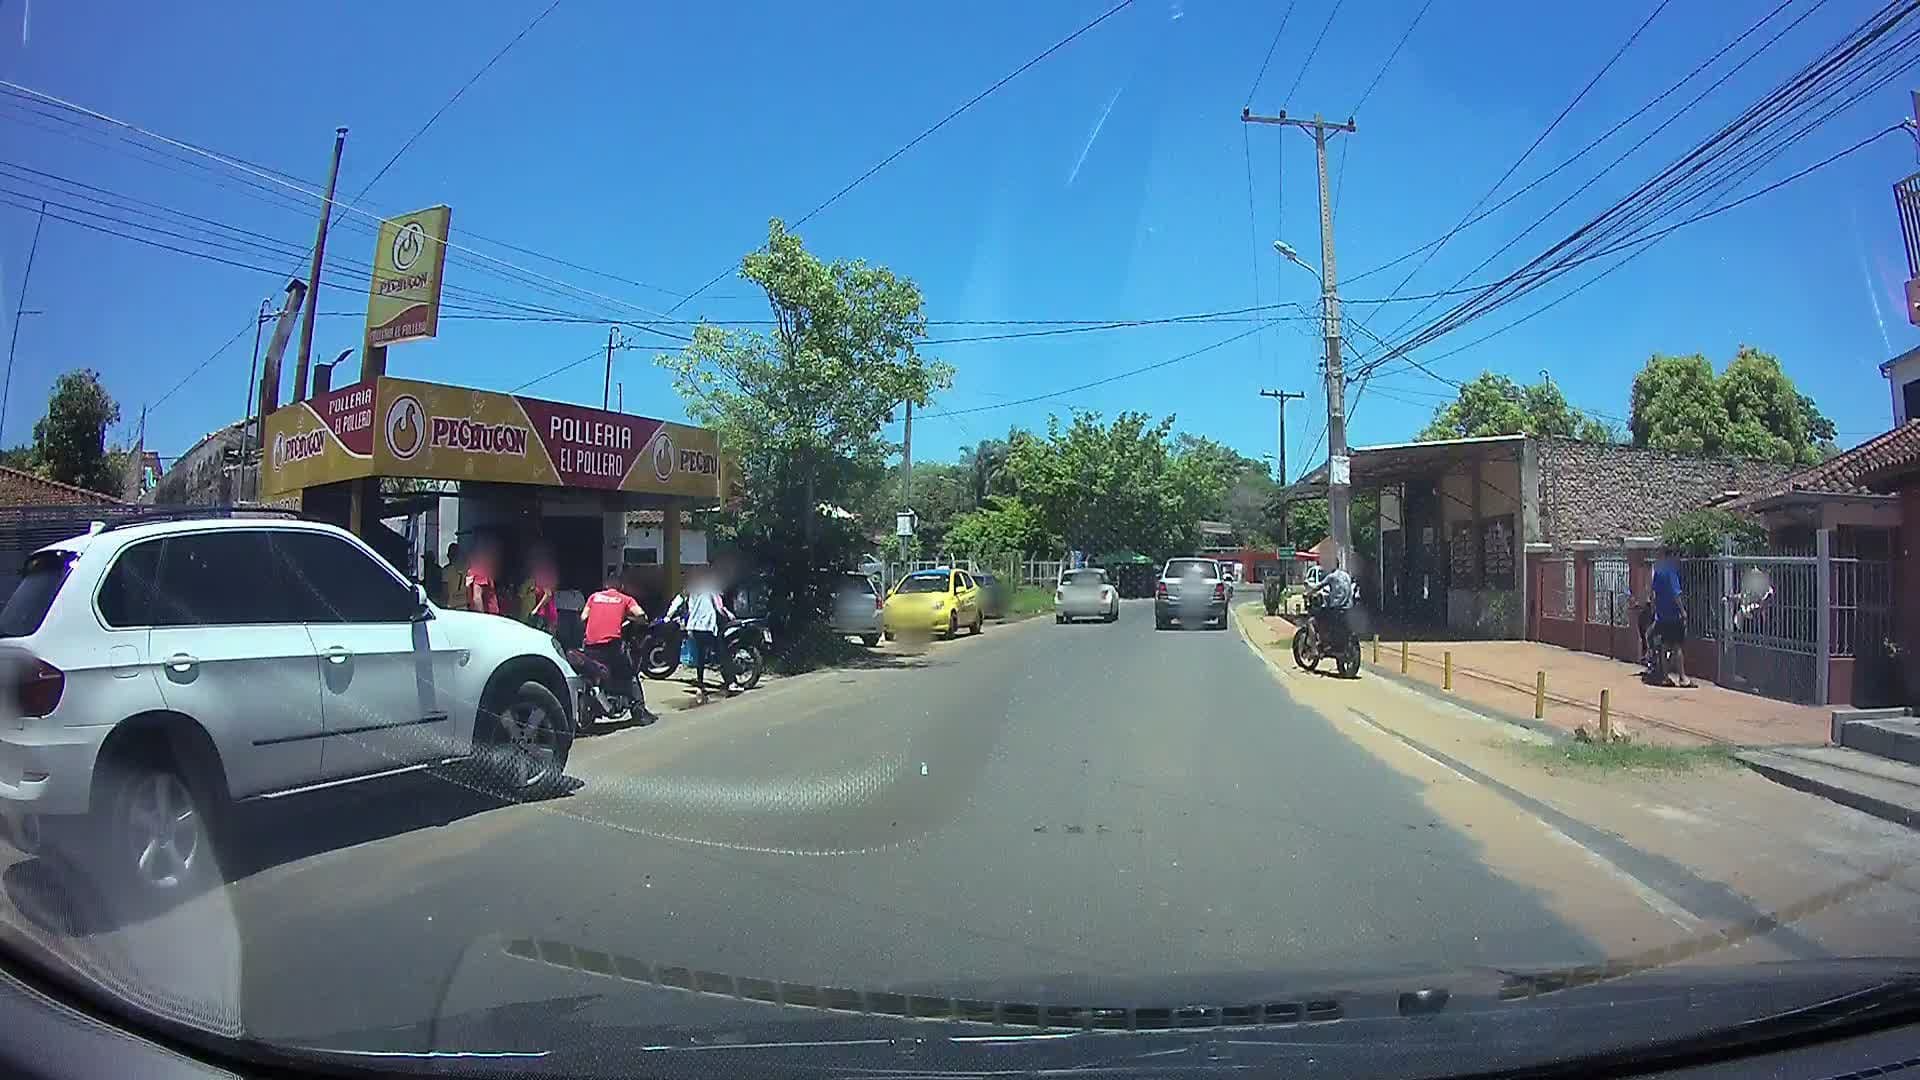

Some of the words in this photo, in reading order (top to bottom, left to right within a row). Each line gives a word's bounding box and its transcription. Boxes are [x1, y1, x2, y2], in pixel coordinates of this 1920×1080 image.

[329, 388, 373, 415] POLLERIA
[335, 418, 341, 435] EL
[342, 409, 372, 433] POLLERO
[430, 415, 529, 458] PECHUGON
[550, 415, 632, 450] POLLERIA
[560, 447, 573, 473] EL
[576, 449, 623, 477] POLLERO
